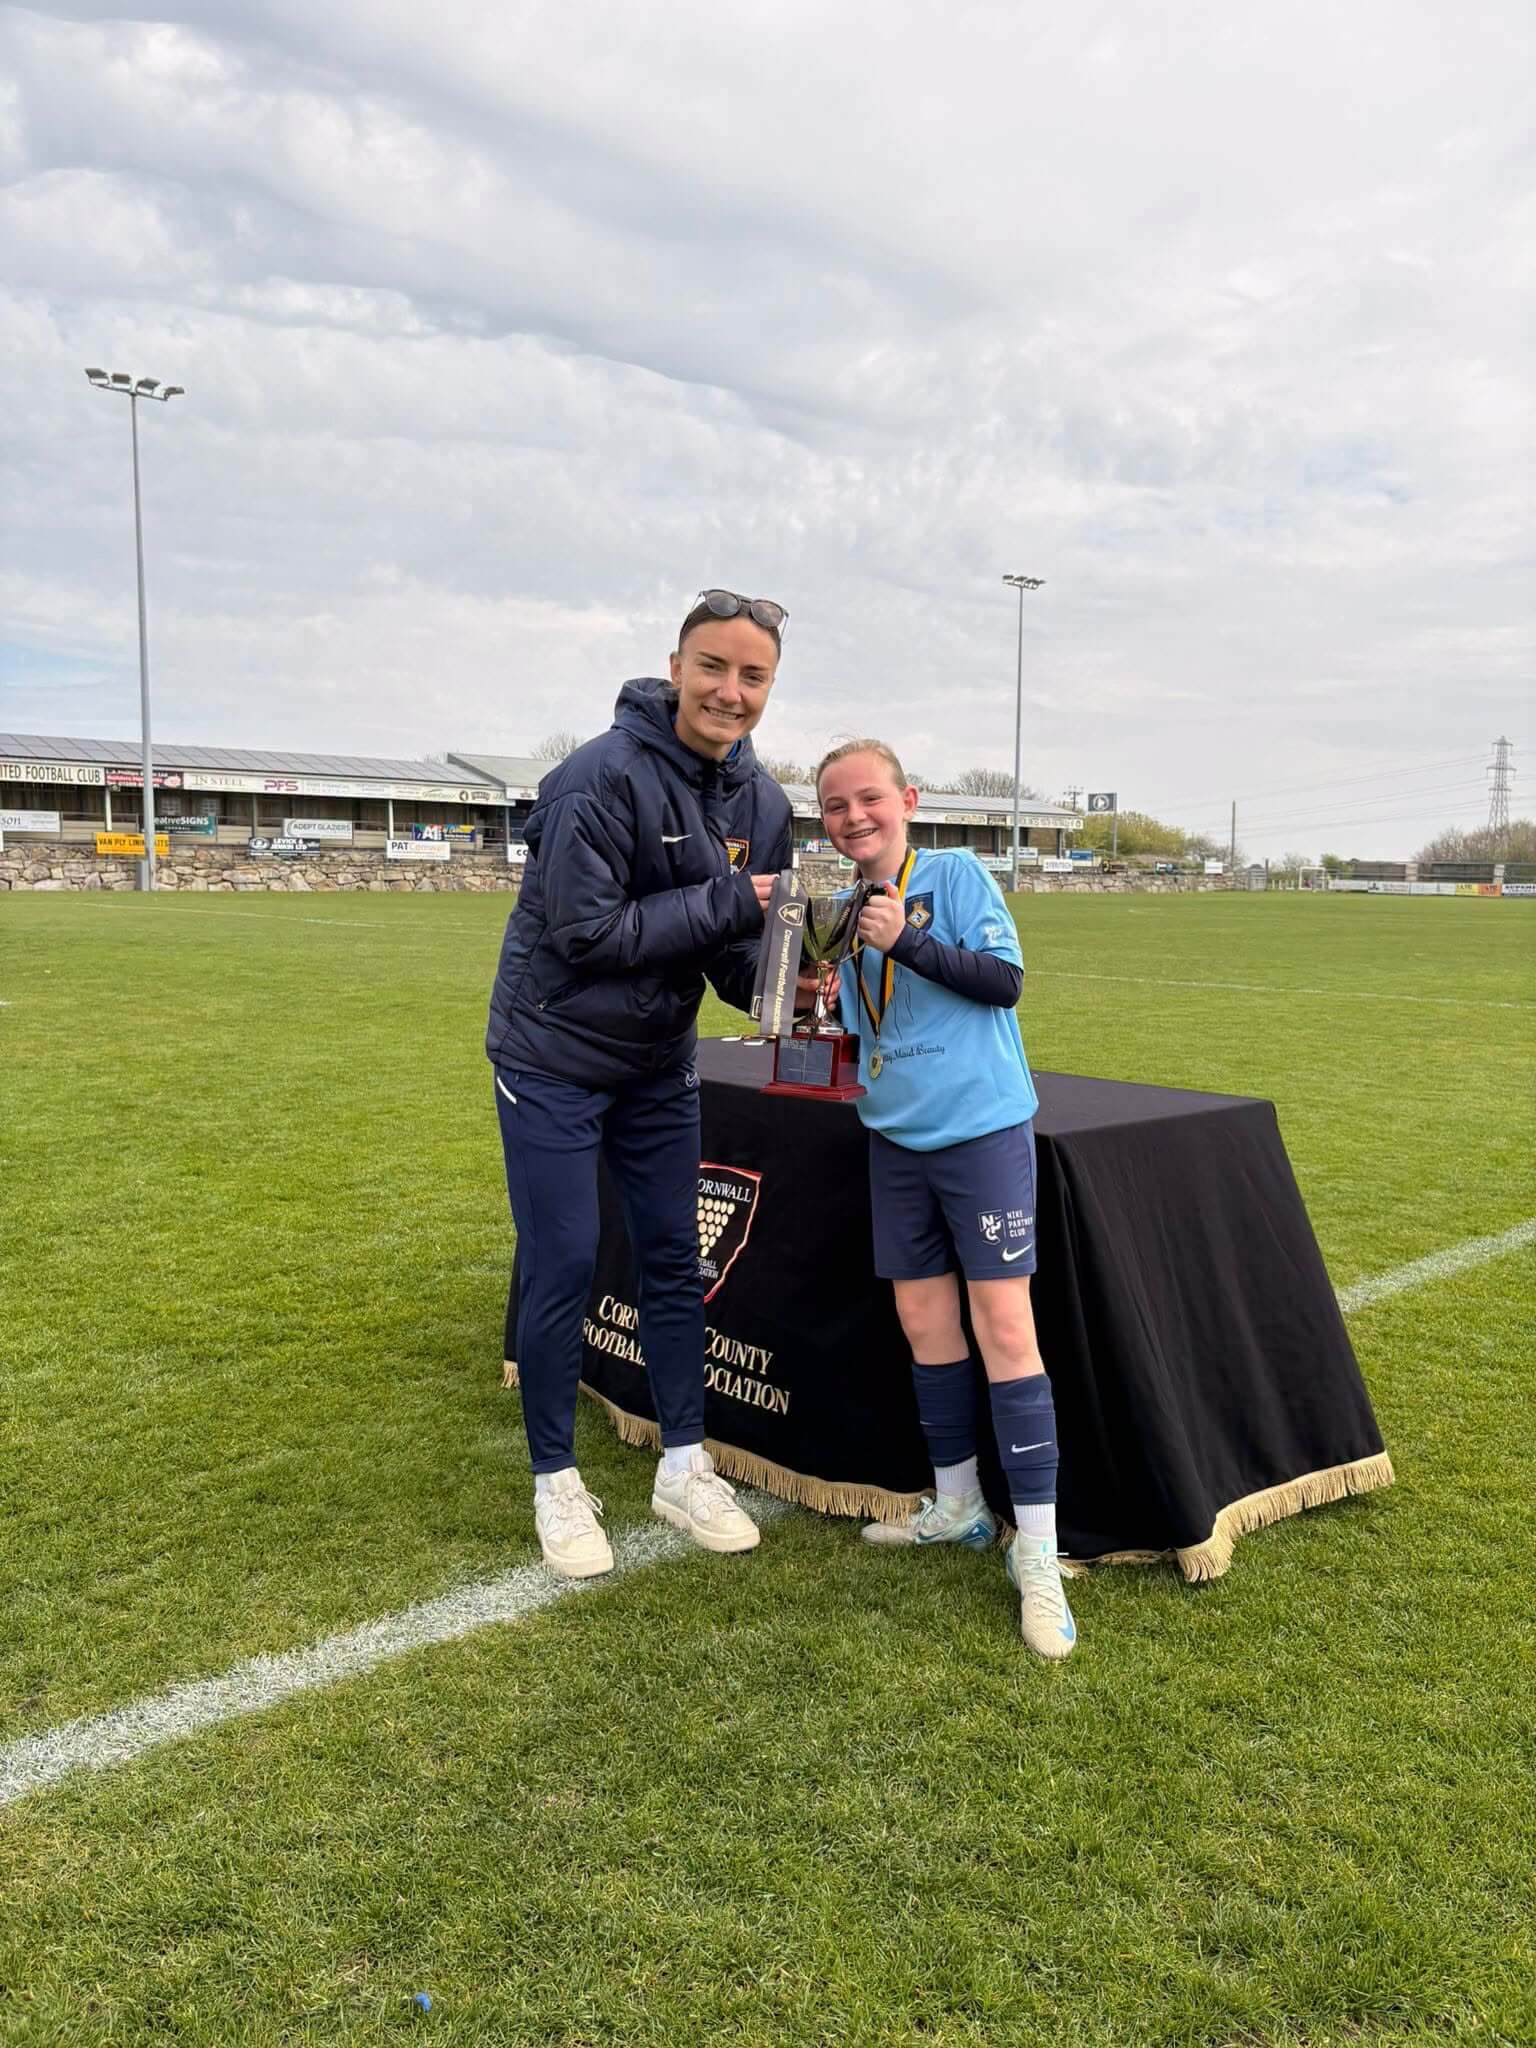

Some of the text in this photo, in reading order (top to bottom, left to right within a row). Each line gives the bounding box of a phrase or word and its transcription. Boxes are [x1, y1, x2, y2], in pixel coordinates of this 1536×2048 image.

[0, 764, 21, 779] ITED
[25, 765, 73, 782] FOOTBALL
[77, 768, 101, 783] CLUB
[264, 779, 298, 791] PFS
[1, 815, 21, 825] son
[154, 816, 209, 825] eativeSIGNS
[319, 824, 351, 832] GLAZIERS
[98, 837, 113, 846] VAN
[114, 838, 127, 847] PLY
[780, 929, 793, 965] Cornwall
[776, 962, 789, 997] Football
[698, 1178, 752, 1203] ORNWALL
[1006, 1209, 1023, 1220] NIKE
[1009, 1228, 1026, 1238] CLUB
[599, 1295, 774, 1375] CORN COUNTY
[582, 1317, 790, 1415] FOOTBAL OCIATION
